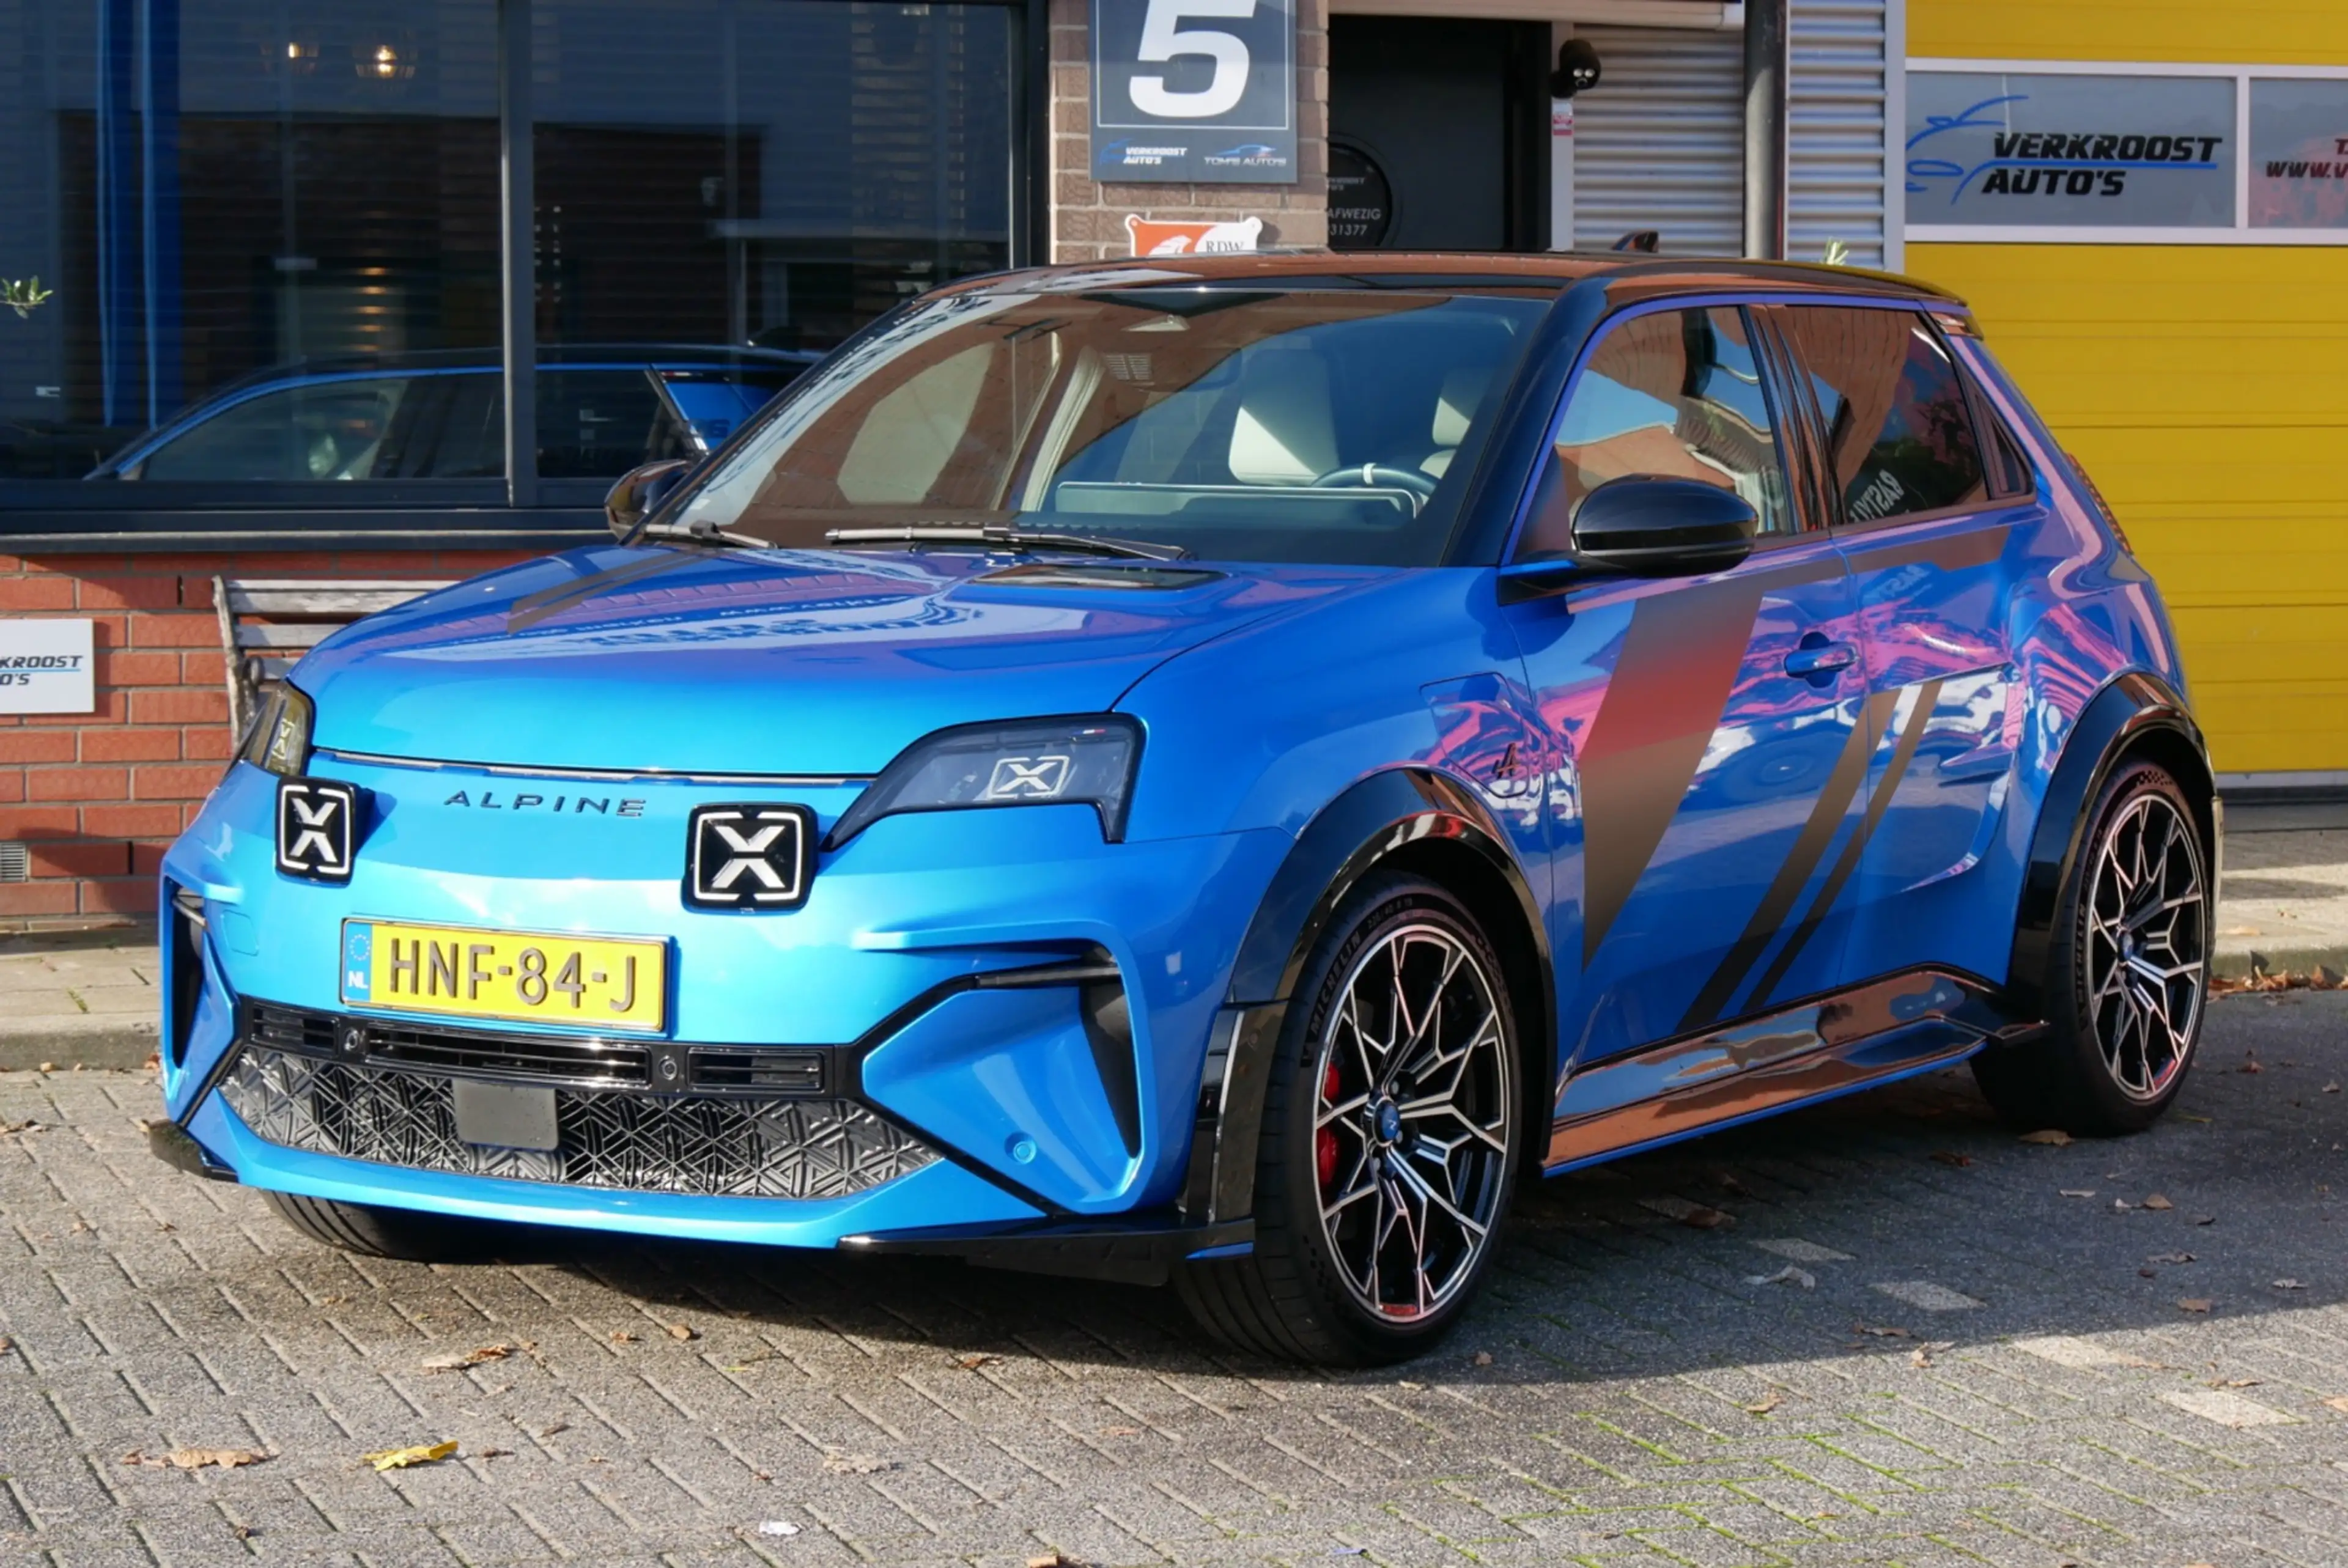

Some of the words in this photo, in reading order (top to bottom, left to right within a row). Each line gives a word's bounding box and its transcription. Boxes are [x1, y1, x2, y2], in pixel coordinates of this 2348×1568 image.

[1129, 0, 1257, 117] 5
[1125, 146, 1188, 156] VERKROOST
[1994, 132, 2223, 162] VERKROOST
[1981, 169, 2127, 196] AUTO'S
[1328, 208, 1382, 220] AFWEZIG
[1329, 223, 1368, 237] 31377
[1206, 240, 1244, 252] RDW
[443, 790, 646, 817] ALPINE
[347, 970, 368, 989] NL
[389, 938, 637, 1013] HNF-84-J
[1310, 930, 1362, 1037] MICHELIN
